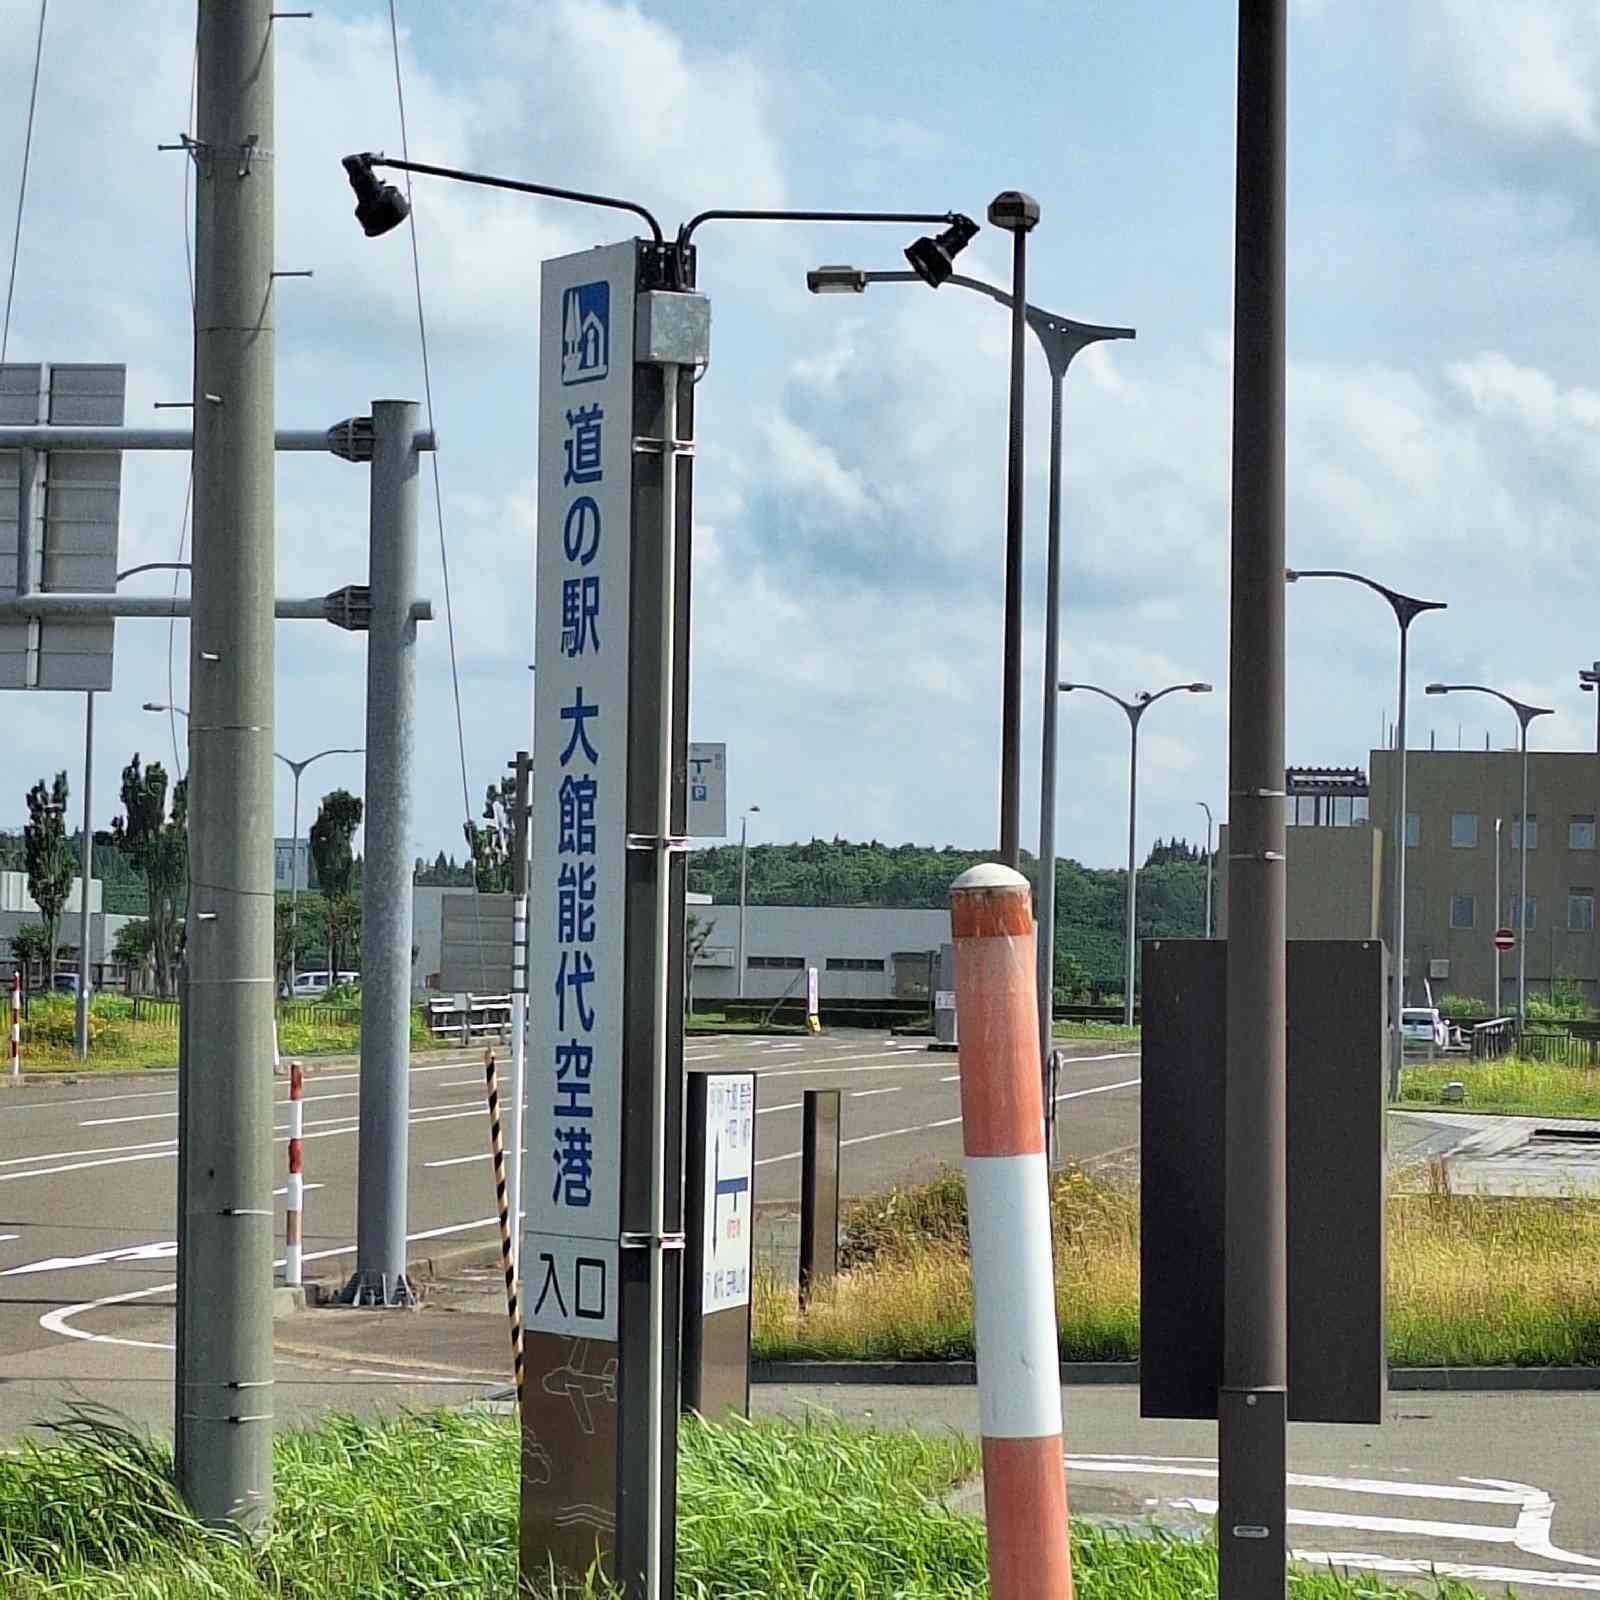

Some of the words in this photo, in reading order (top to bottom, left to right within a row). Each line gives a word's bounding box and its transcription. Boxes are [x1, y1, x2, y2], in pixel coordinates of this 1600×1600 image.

[560, 405, 604, 657] 道の駅
[553, 687, 599, 1207] 大館能代空港
[535, 1254, 606, 1320] 入口
